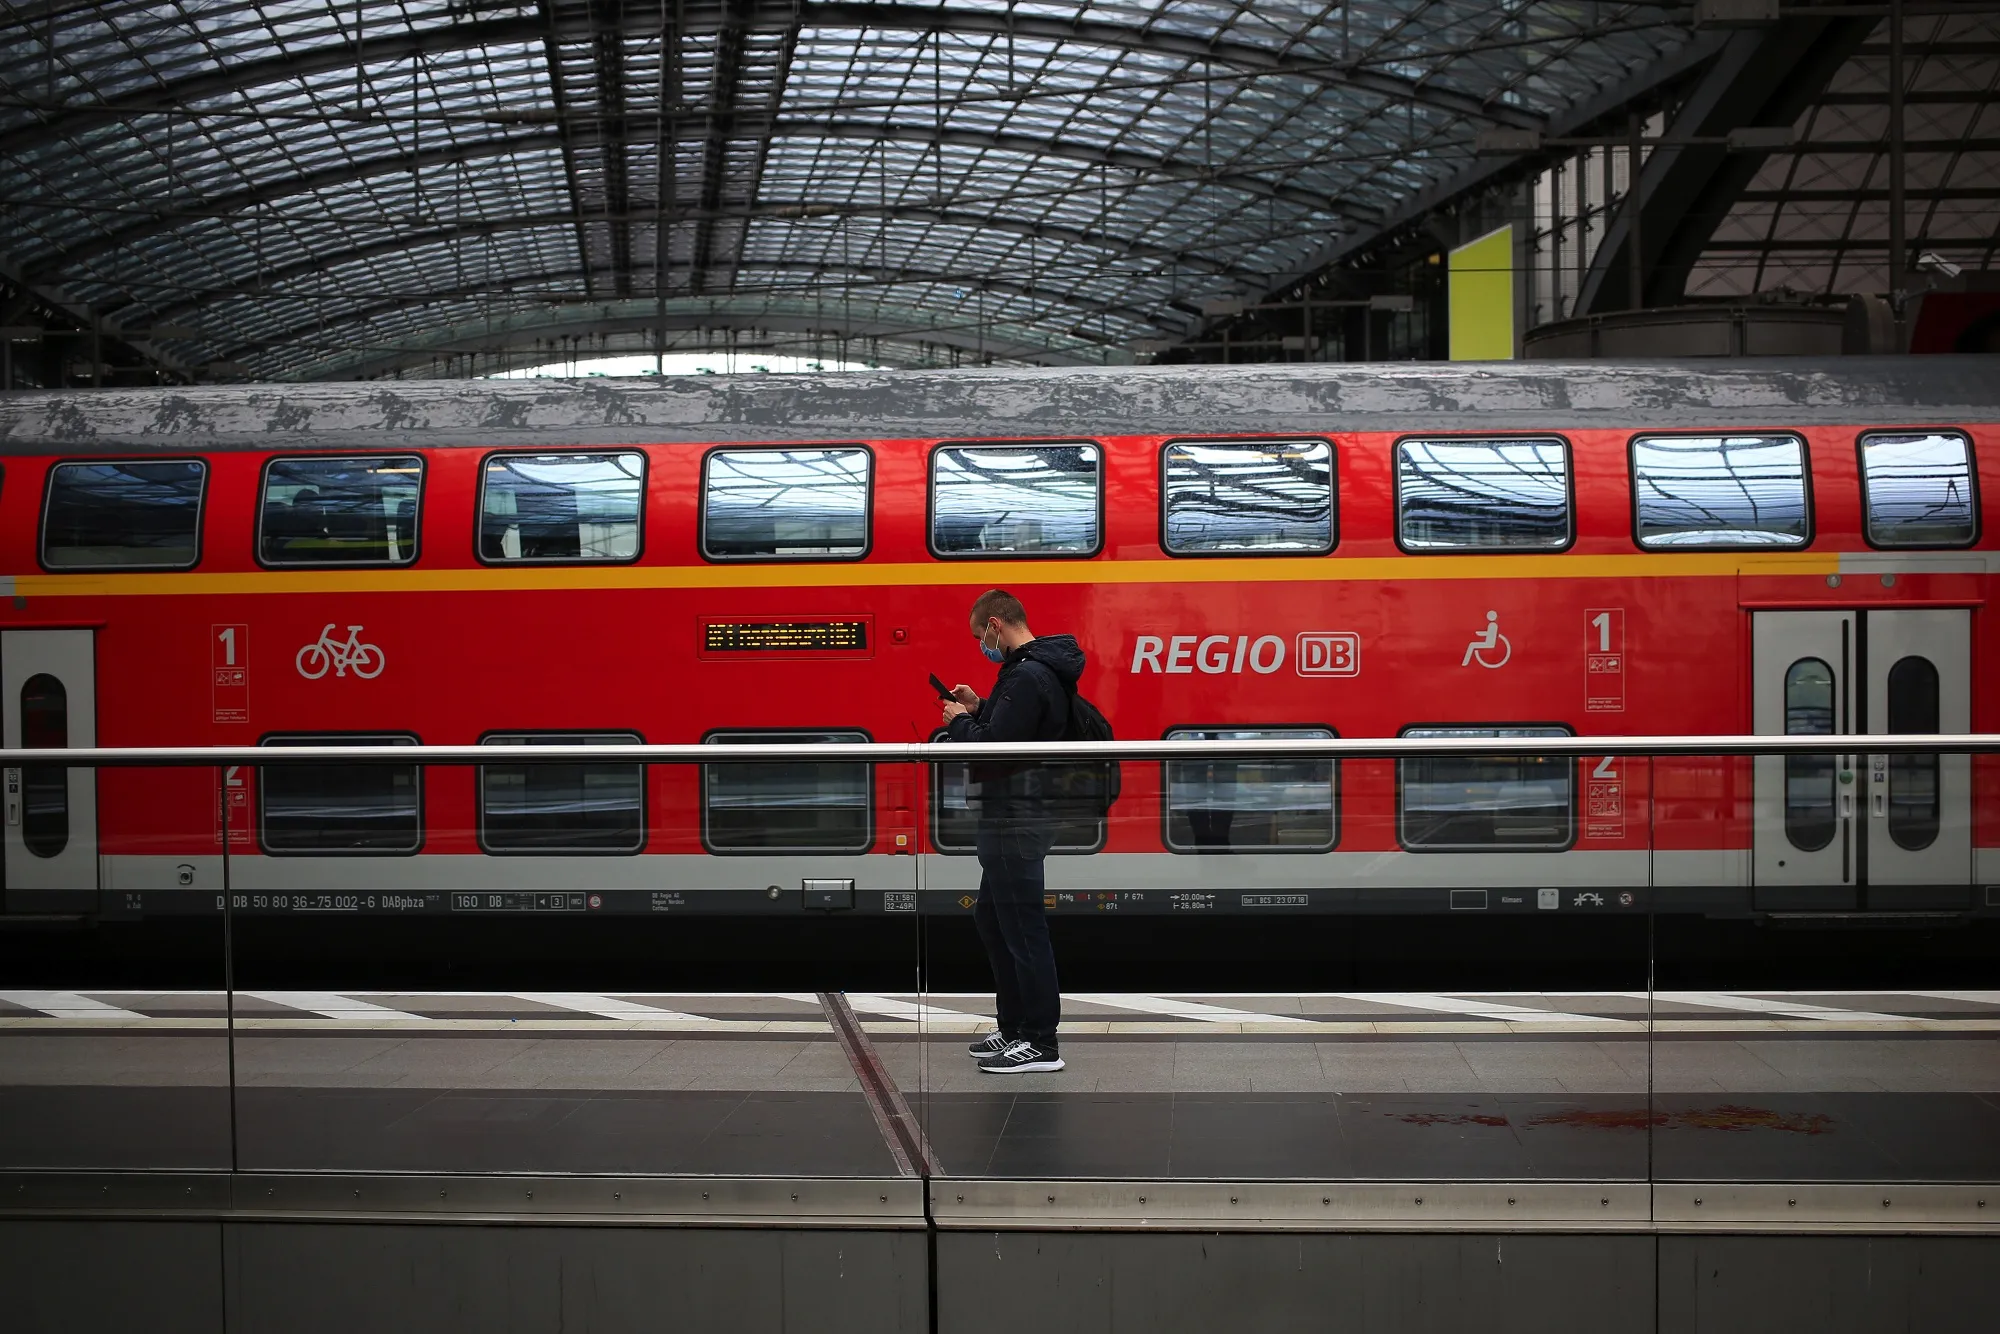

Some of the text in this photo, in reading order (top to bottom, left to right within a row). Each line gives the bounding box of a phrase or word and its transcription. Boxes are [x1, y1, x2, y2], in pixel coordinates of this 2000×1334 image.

[218, 627, 236, 666] 1
[1591, 612, 1610, 652] 1
[1130, 634, 1286, 674] REGIO
[1302, 637, 1355, 672] DB
[233, 896, 248, 908] DB
[253, 896, 268, 908] 50
[272, 896, 288, 908] 80
[382, 895, 424, 911] DABpbza
[457, 896, 478, 908] 160
[489, 896, 502, 908] DB
